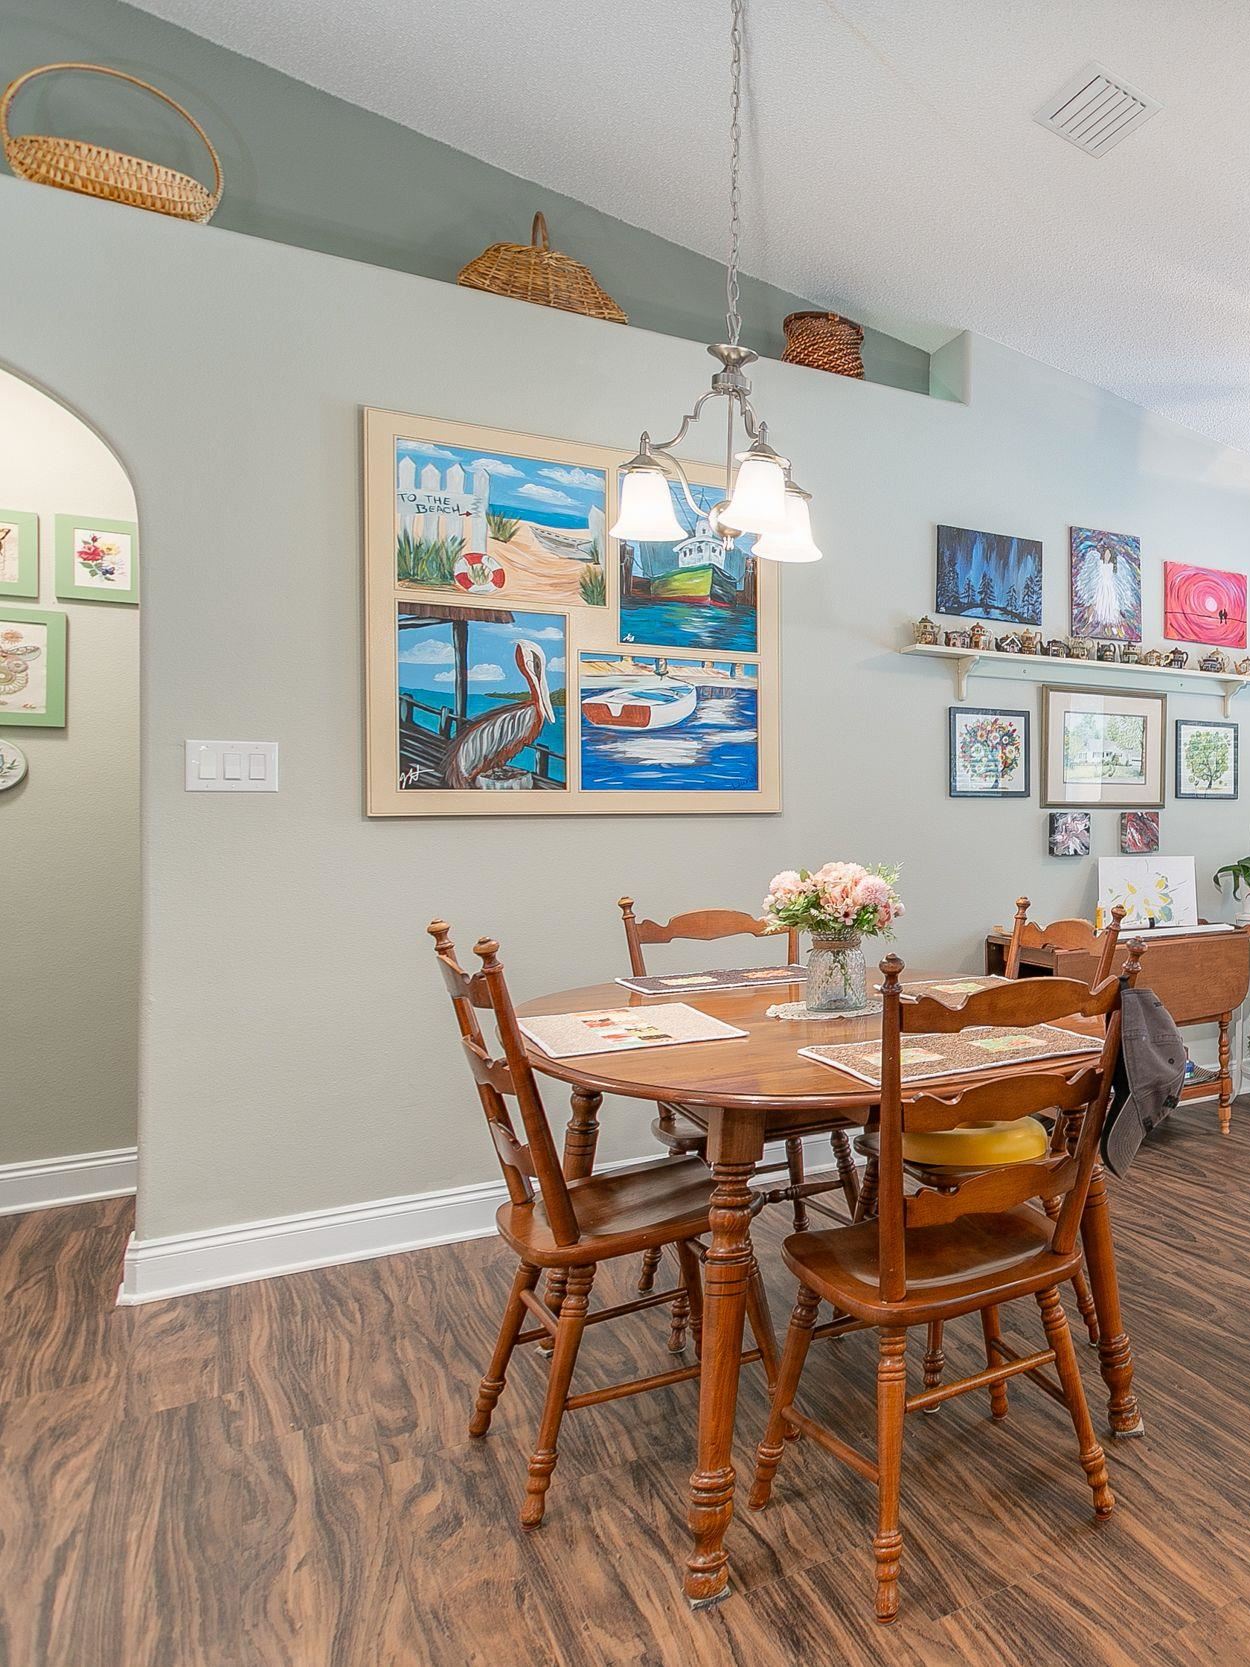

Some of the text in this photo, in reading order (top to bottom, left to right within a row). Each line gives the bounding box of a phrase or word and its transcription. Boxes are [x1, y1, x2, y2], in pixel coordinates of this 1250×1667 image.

[397, 493, 451, 506] TO THE
[415, 503, 461, 514] BEACH
